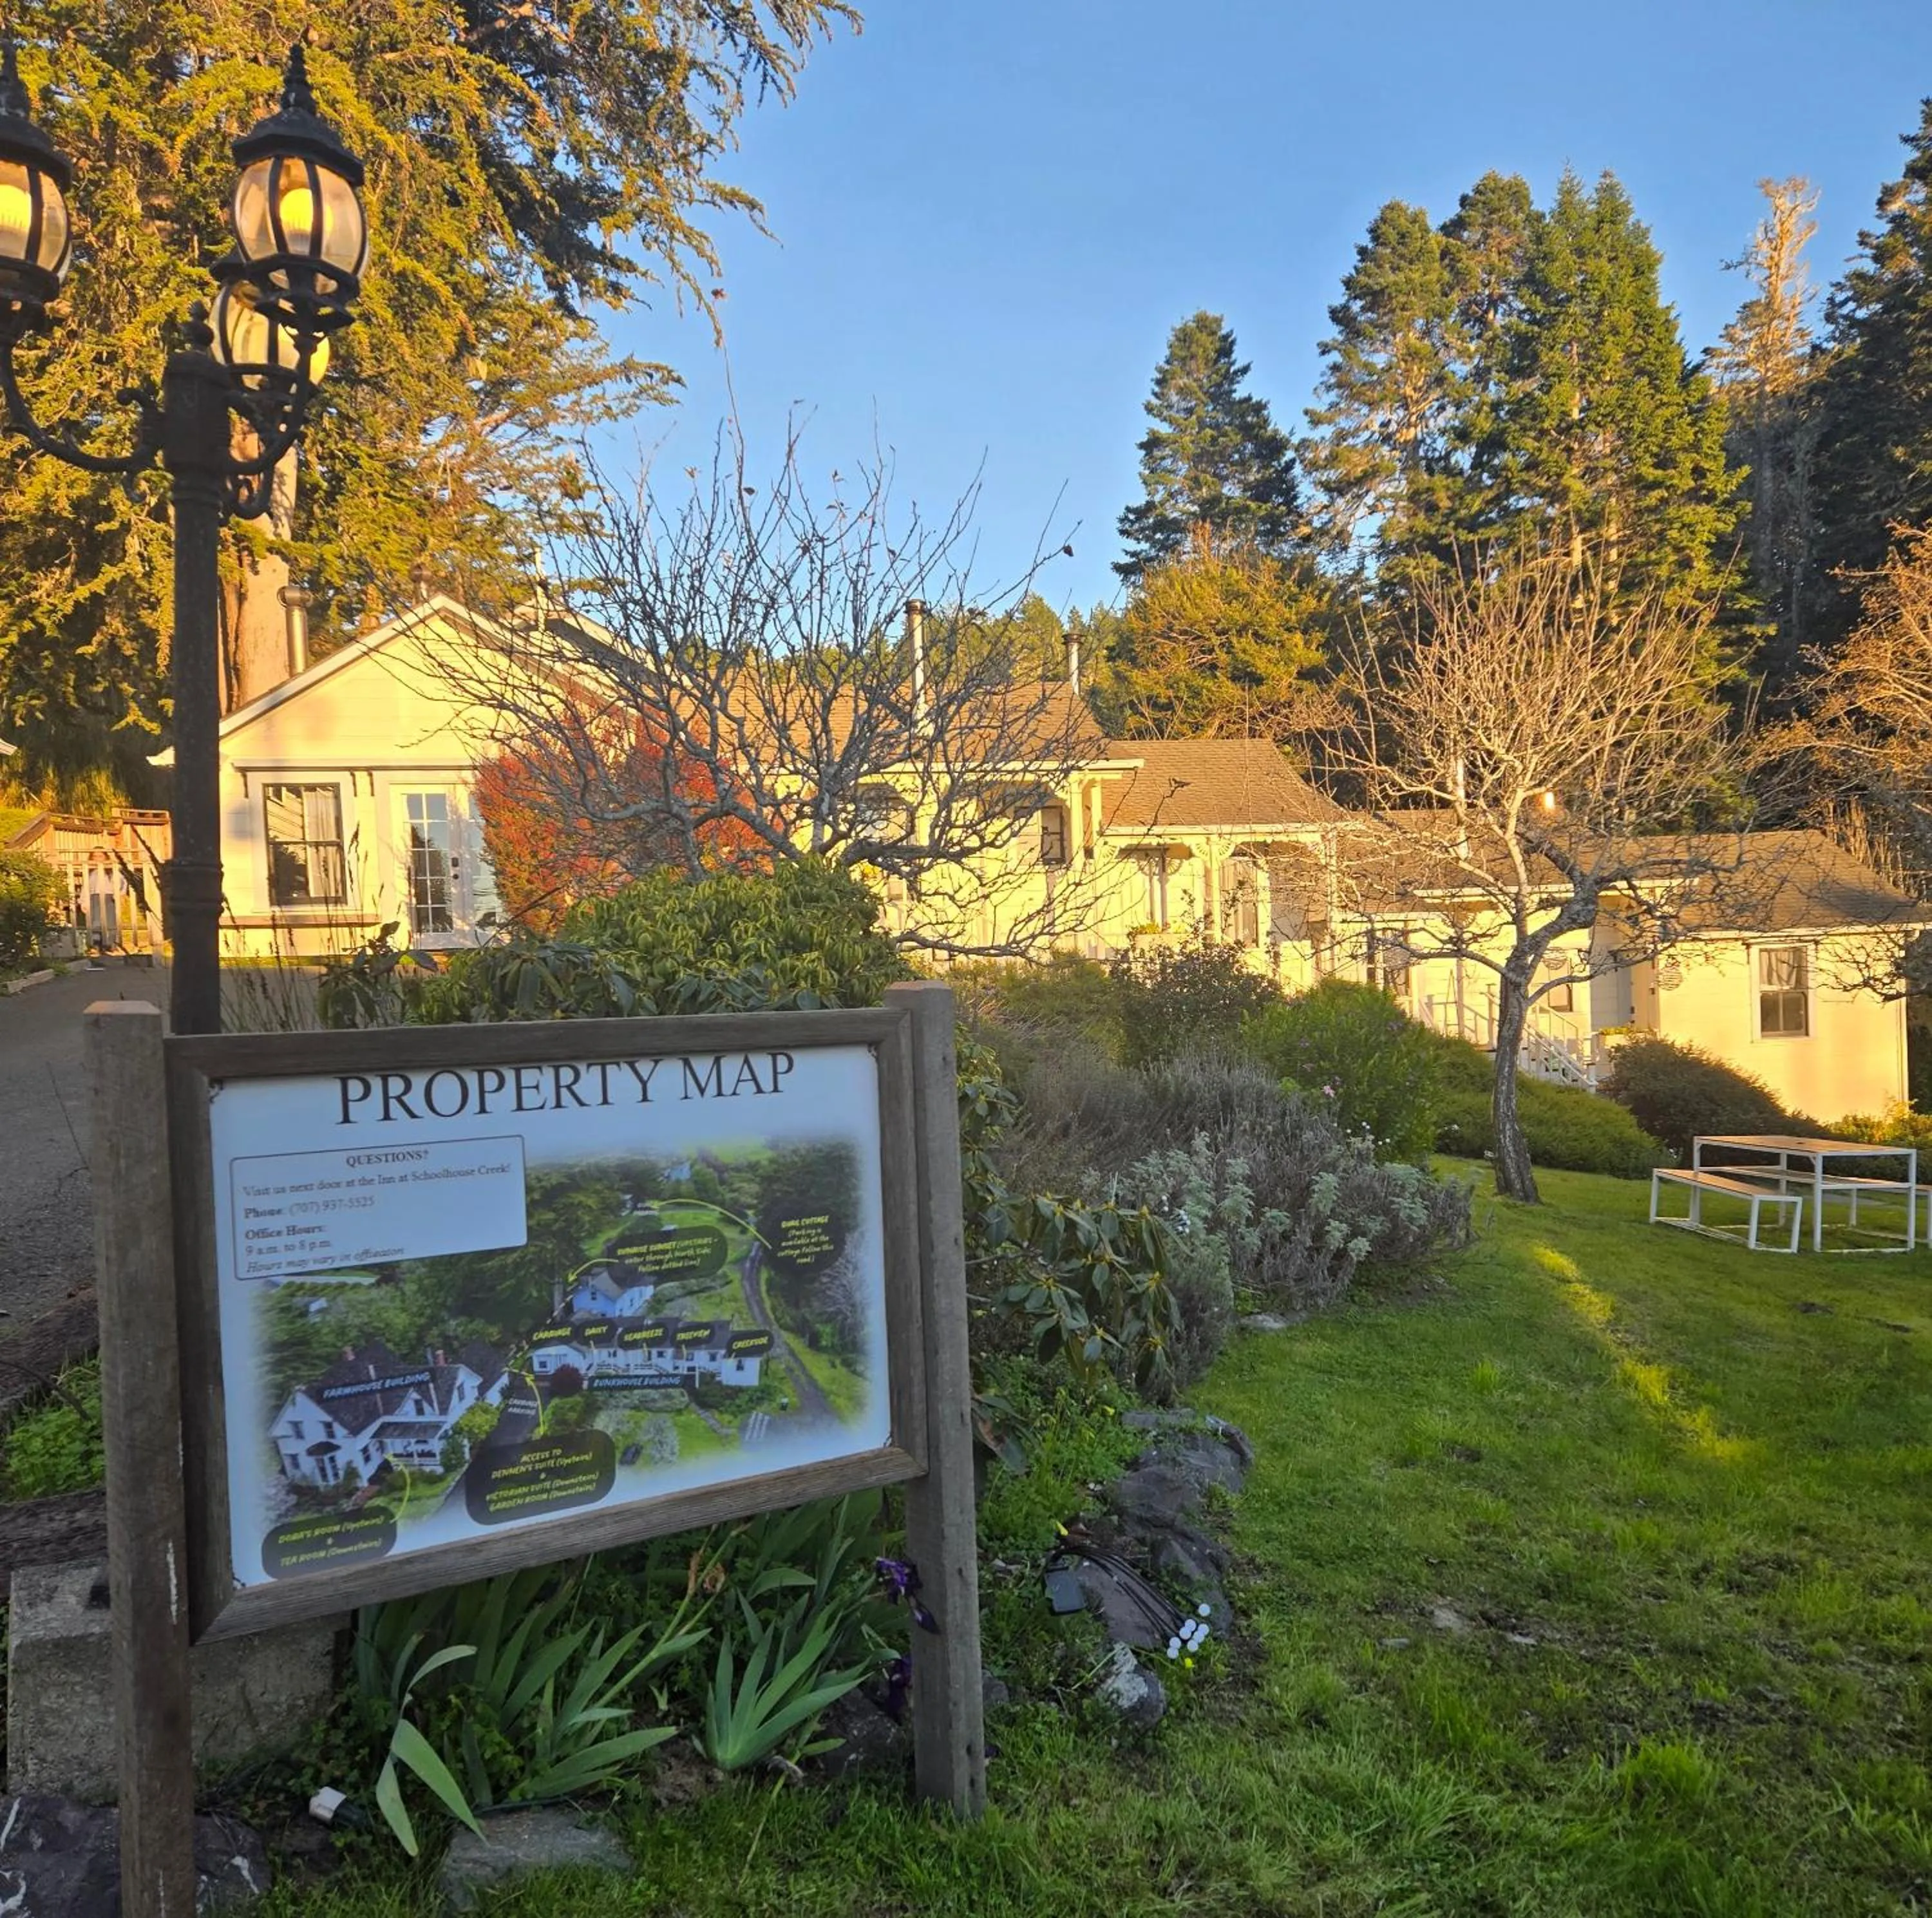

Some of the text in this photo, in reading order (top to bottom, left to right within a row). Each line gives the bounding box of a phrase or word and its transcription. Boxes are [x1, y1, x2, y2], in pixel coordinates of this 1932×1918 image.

[334, 1052, 794, 1124] PROPERTY MAP
[346, 1150, 429, 1167] QUESTIONS?
[243, 1186, 269, 1196] Visit
[289, 1183, 315, 1193] next
[317, 1180, 341, 1190] door
[346, 1179, 357, 1188] at
[358, 1176, 374, 1186] the
[377, 1174, 396, 1184] Inn
[399, 1173, 408, 1182] at
[411, 1167, 475, 1182] Schoolhouse
[289, 1201, 320, 1216] (707)
[245, 1228, 282, 1240] Office
[245, 1245, 253, 1255] 9
[284, 1242, 296, 1251] to
[298, 1240, 305, 1250] 8
[247, 1261, 282, 1273] Hours
[286, 1258, 308, 1269] may
[312, 1256, 336, 1265] vary
[384, 1372, 431, 1388] BUILDING
[520, 1448, 562, 1463] ACCESS TO
[524, 1492, 547, 1504] ROOM
